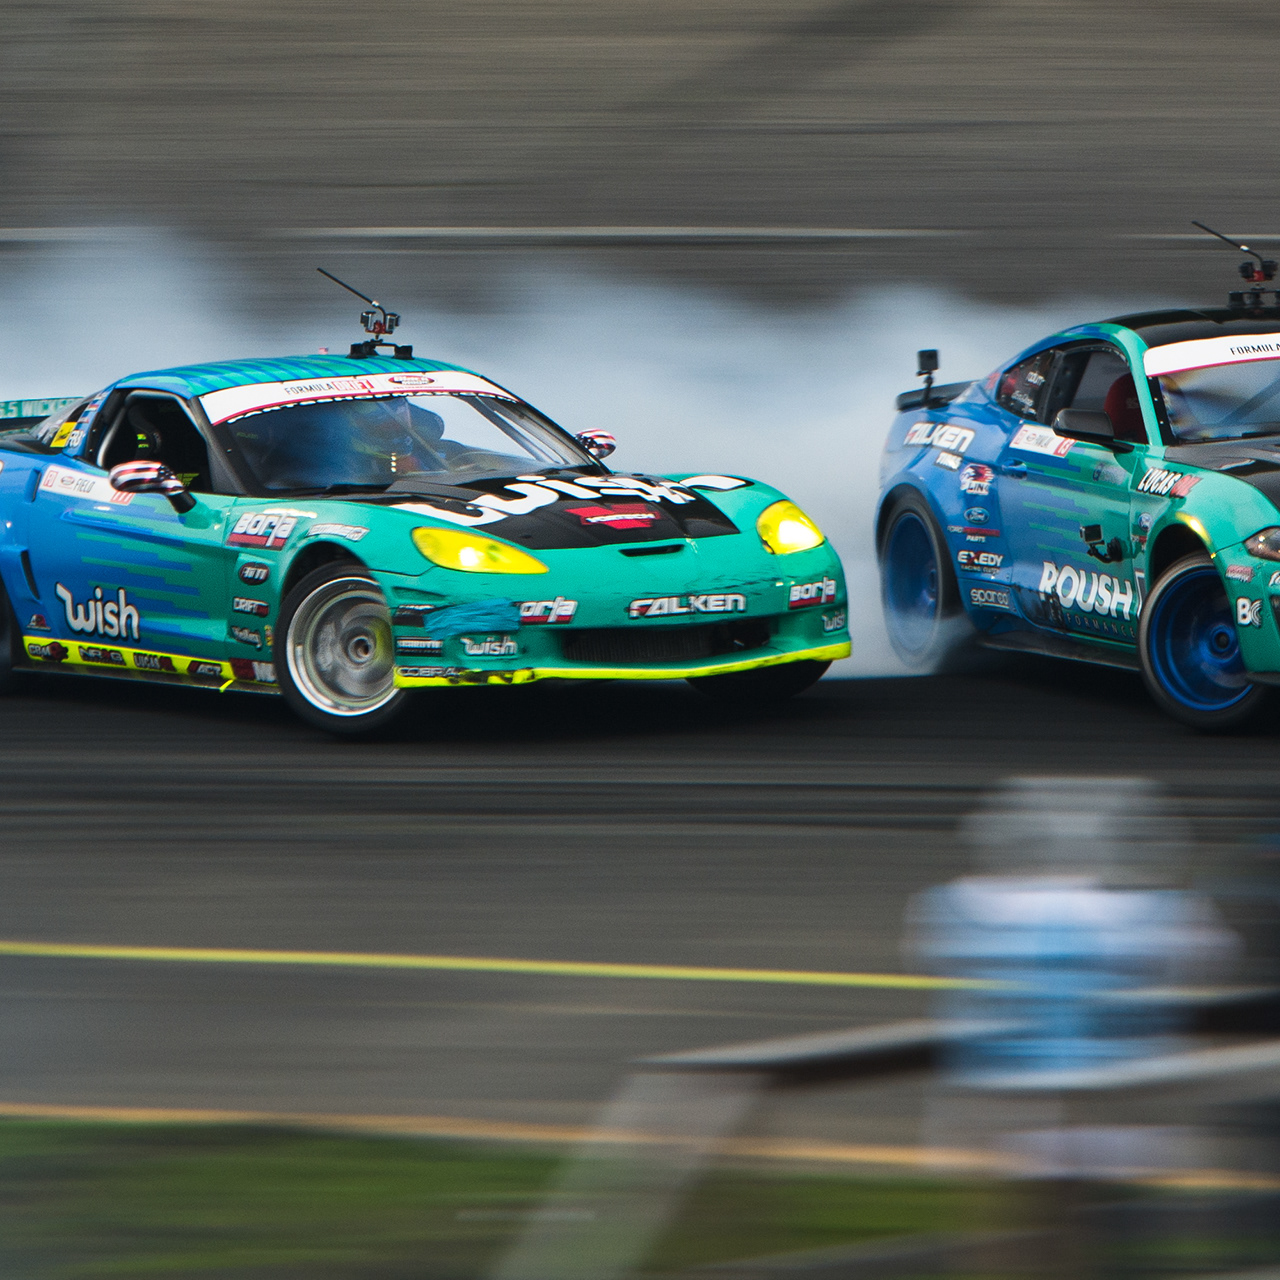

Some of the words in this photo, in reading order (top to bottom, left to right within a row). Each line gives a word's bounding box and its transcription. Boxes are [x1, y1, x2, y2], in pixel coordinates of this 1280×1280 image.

[284, 383, 335, 395] FORMULA
[333, 379, 374, 392] DRIFT
[903, 422, 976, 453] FALKEN
[73, 478, 96, 494] FIELD
[1136, 467, 1183, 496] LUCAS
[957, 550, 1003, 567] EXEDY
[971, 588, 1009, 607] sparco
[1039, 561, 1133, 621] ROUSH
[56, 582, 139, 640] wish
[628, 593, 746, 619] FALKEN
[460, 635, 518, 655] wish
[397, 666, 459, 677] COBRA
